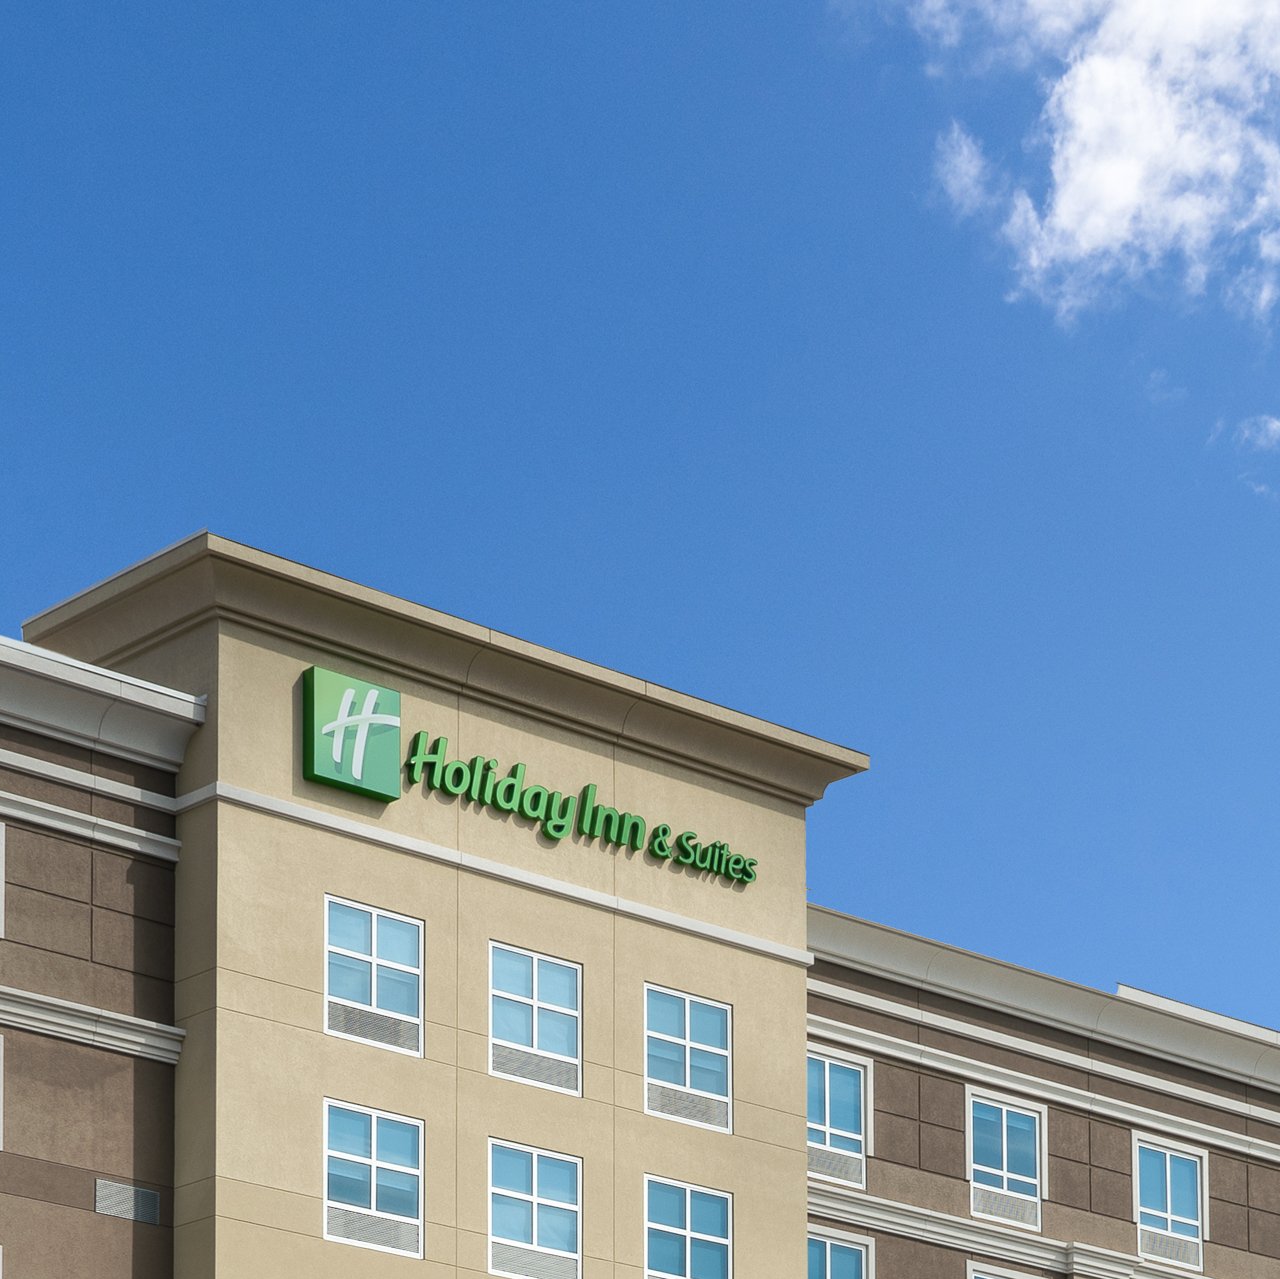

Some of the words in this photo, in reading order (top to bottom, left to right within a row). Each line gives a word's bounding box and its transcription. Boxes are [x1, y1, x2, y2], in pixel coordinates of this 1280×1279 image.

[407, 730, 577, 840] Holiday
[578, 783, 647, 852] Inn
[650, 823, 673, 860] &
[674, 831, 758, 884] Suites
